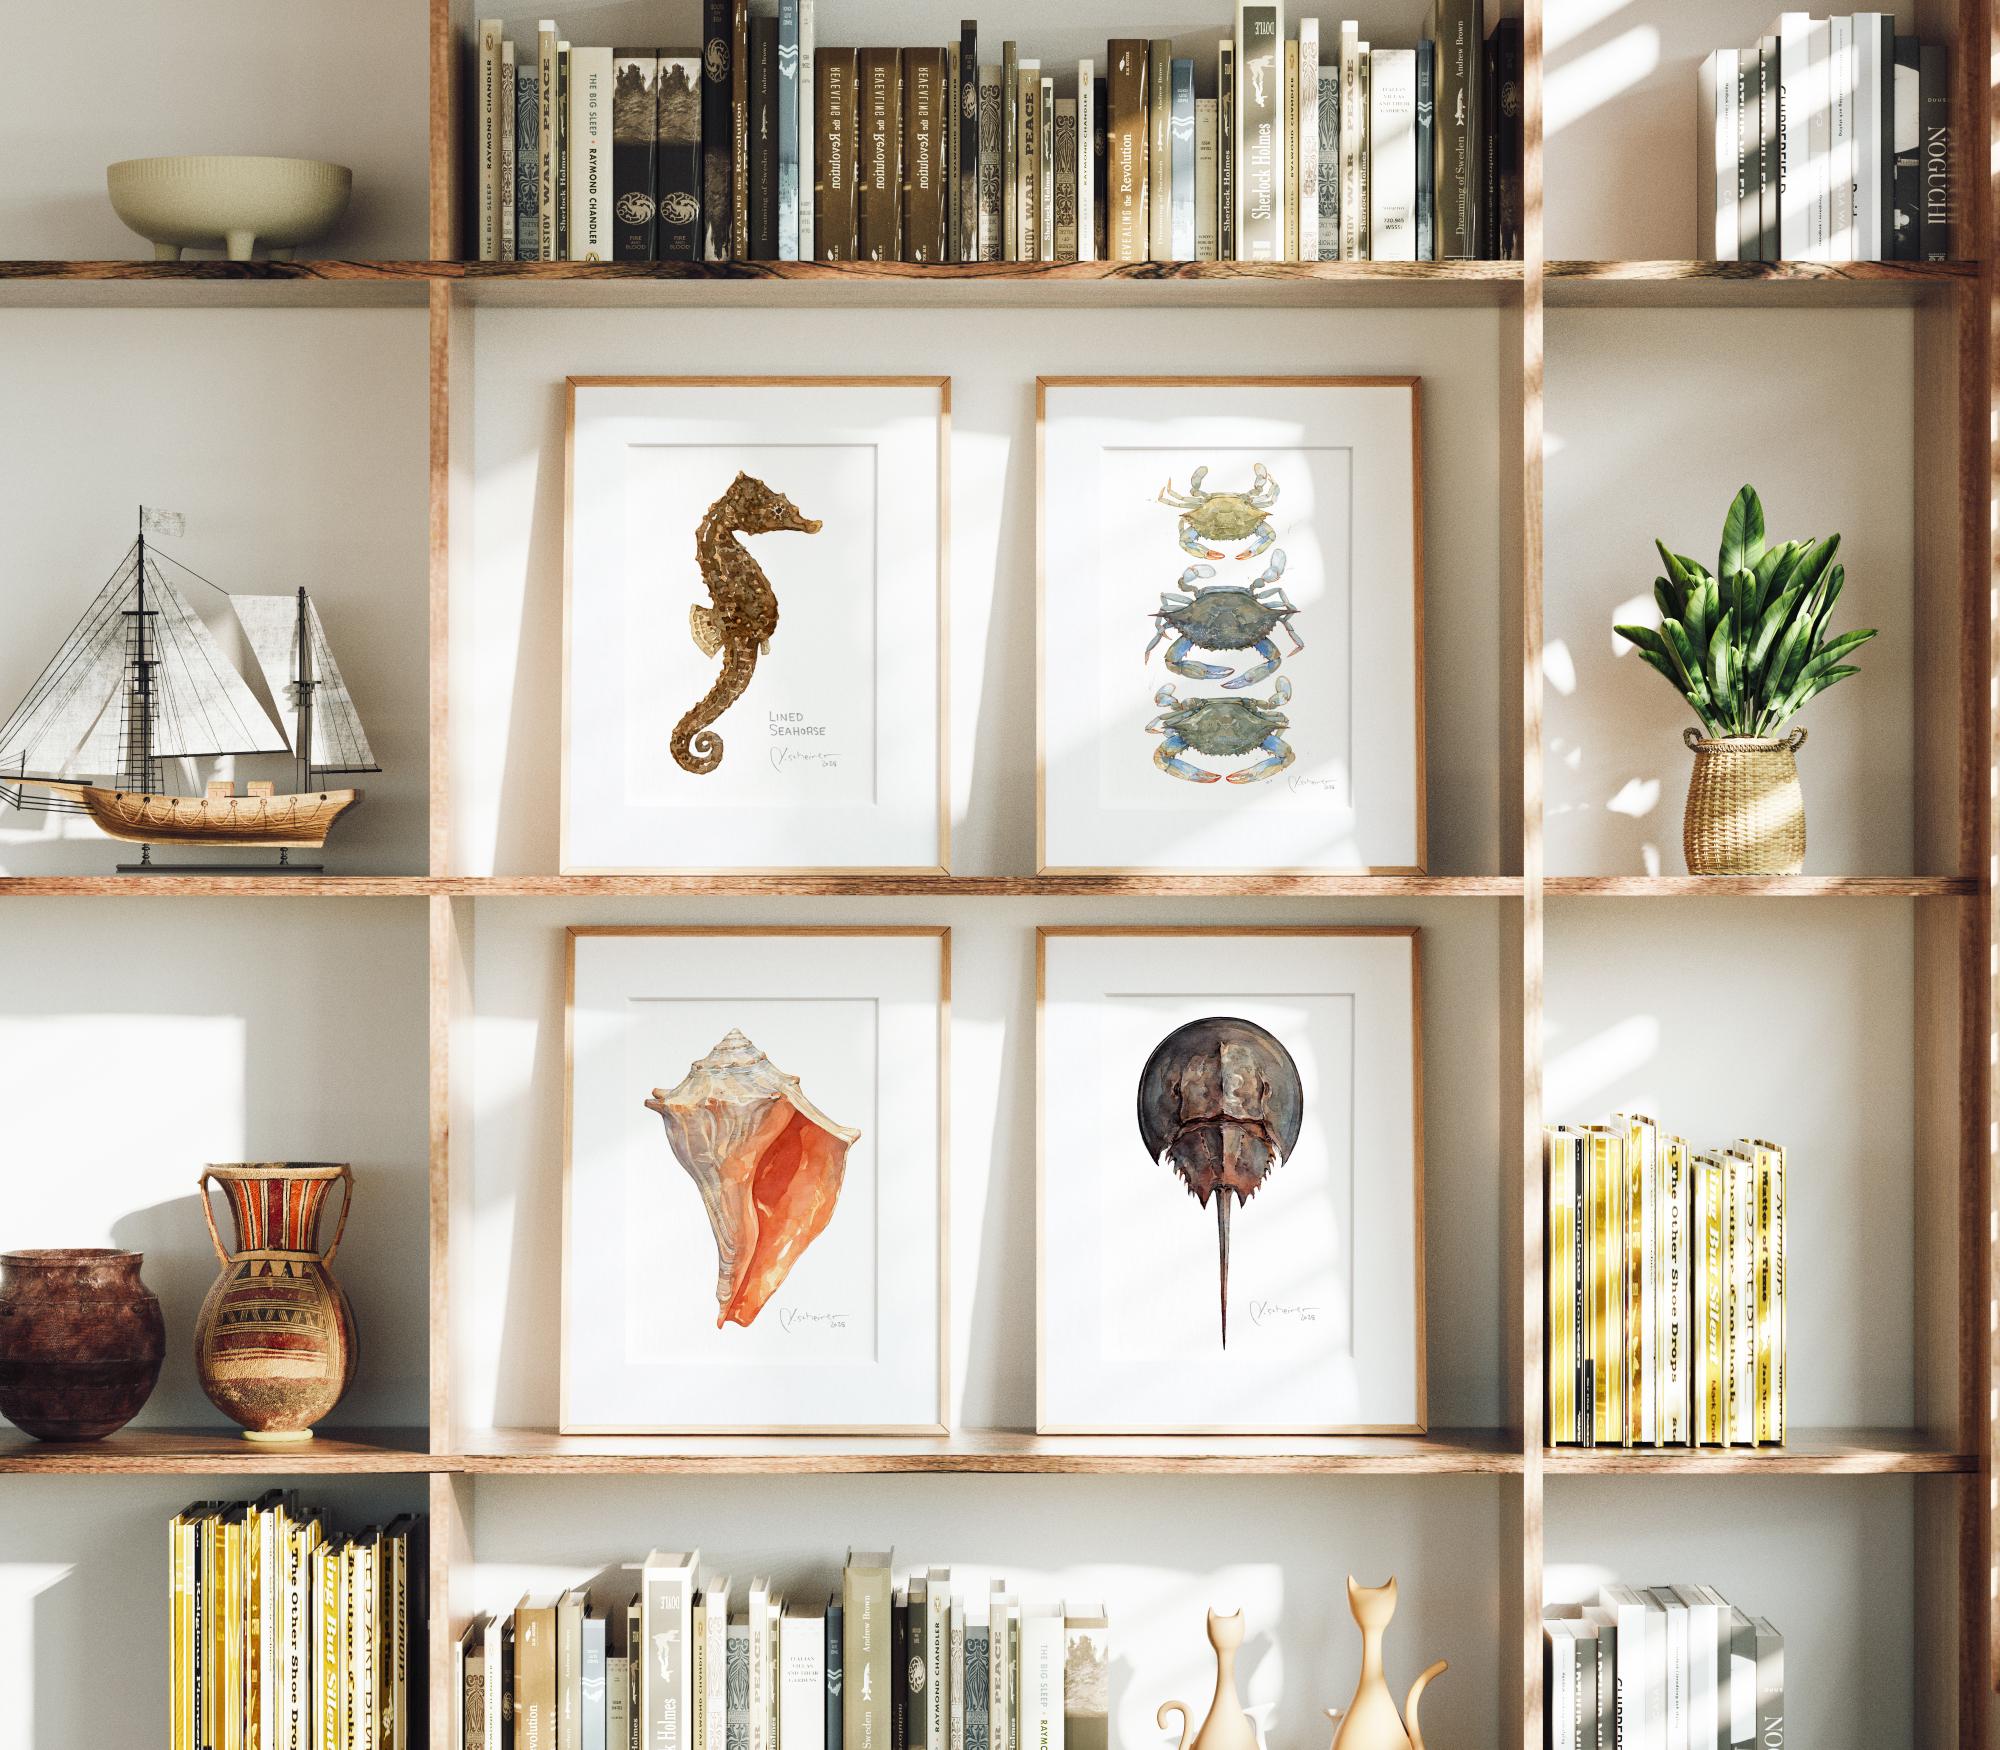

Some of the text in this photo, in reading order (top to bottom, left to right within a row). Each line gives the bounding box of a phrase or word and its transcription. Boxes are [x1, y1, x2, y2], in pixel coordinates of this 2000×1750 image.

[1255, 21, 1275, 35] DOYLE
[589, 73, 597, 245] THE BIG SLEEP RAYMOND CHANDLER
[1455, 20, 1467, 235] Dreaming of Sweden Andrew Brown
[1024, 92, 1034, 261] LSTOY WAR PEACE
[1120, 134, 1132, 193] Revolution
[1252, 123, 1271, 220] Sherlock Holmes
[1927, 126, 1947, 224] NOGUCHI
[761, 197, 769, 241] Dreaming
[1123, 195, 1132, 207] the
[1709, 1227, 1719, 1277] But
[1709, 1282, 1719, 1366] Silent
[325, 1612, 336, 1665] But
[862, 1595, 871, 1749] Sweden Andrew Brown
[526, 1704, 538, 1750] evolution
[657, 1698, 677, 1741] Holmes
[1040, 1644, 1048, 1750] THE BIG SLEEP RAYM
